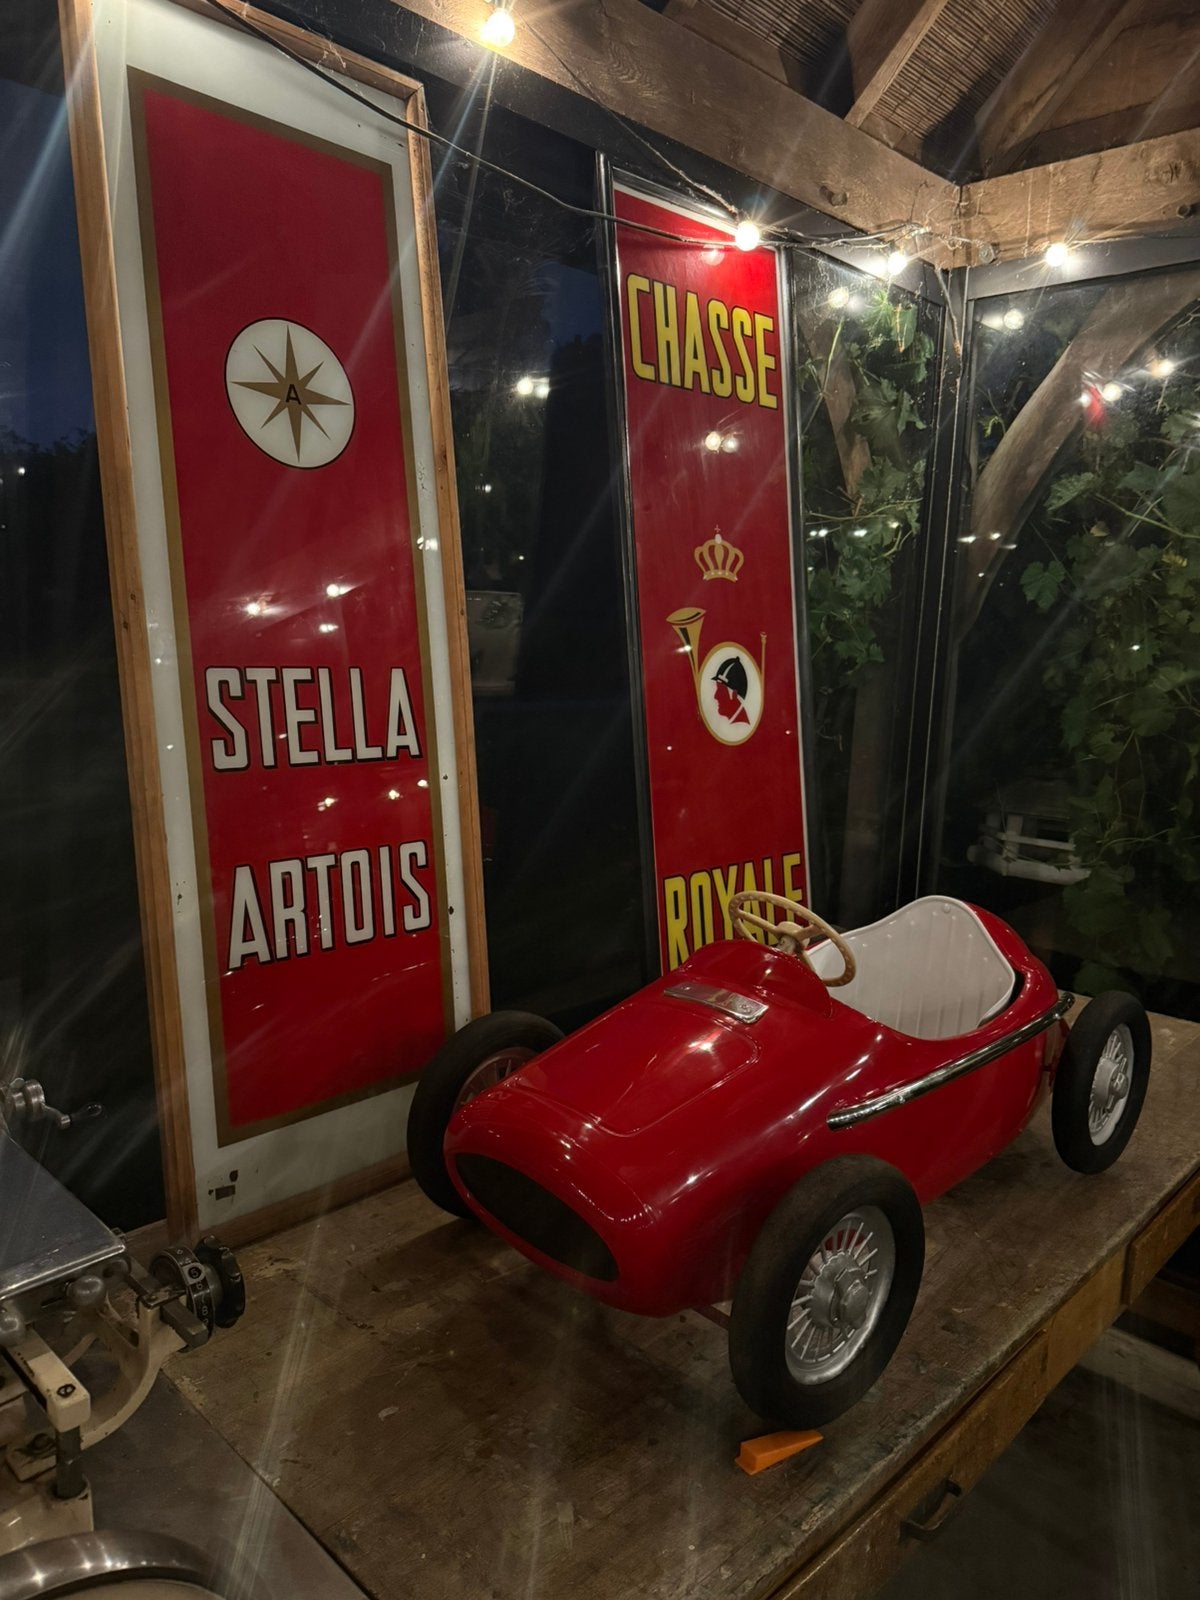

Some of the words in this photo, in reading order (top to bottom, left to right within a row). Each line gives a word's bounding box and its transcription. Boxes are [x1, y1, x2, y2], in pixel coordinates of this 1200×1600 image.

[285, 383, 302, 405] A
[626, 272, 778, 410] CHASSE
[205, 665, 423, 771] STELLA
[227, 839, 431, 970] ARTOIS
